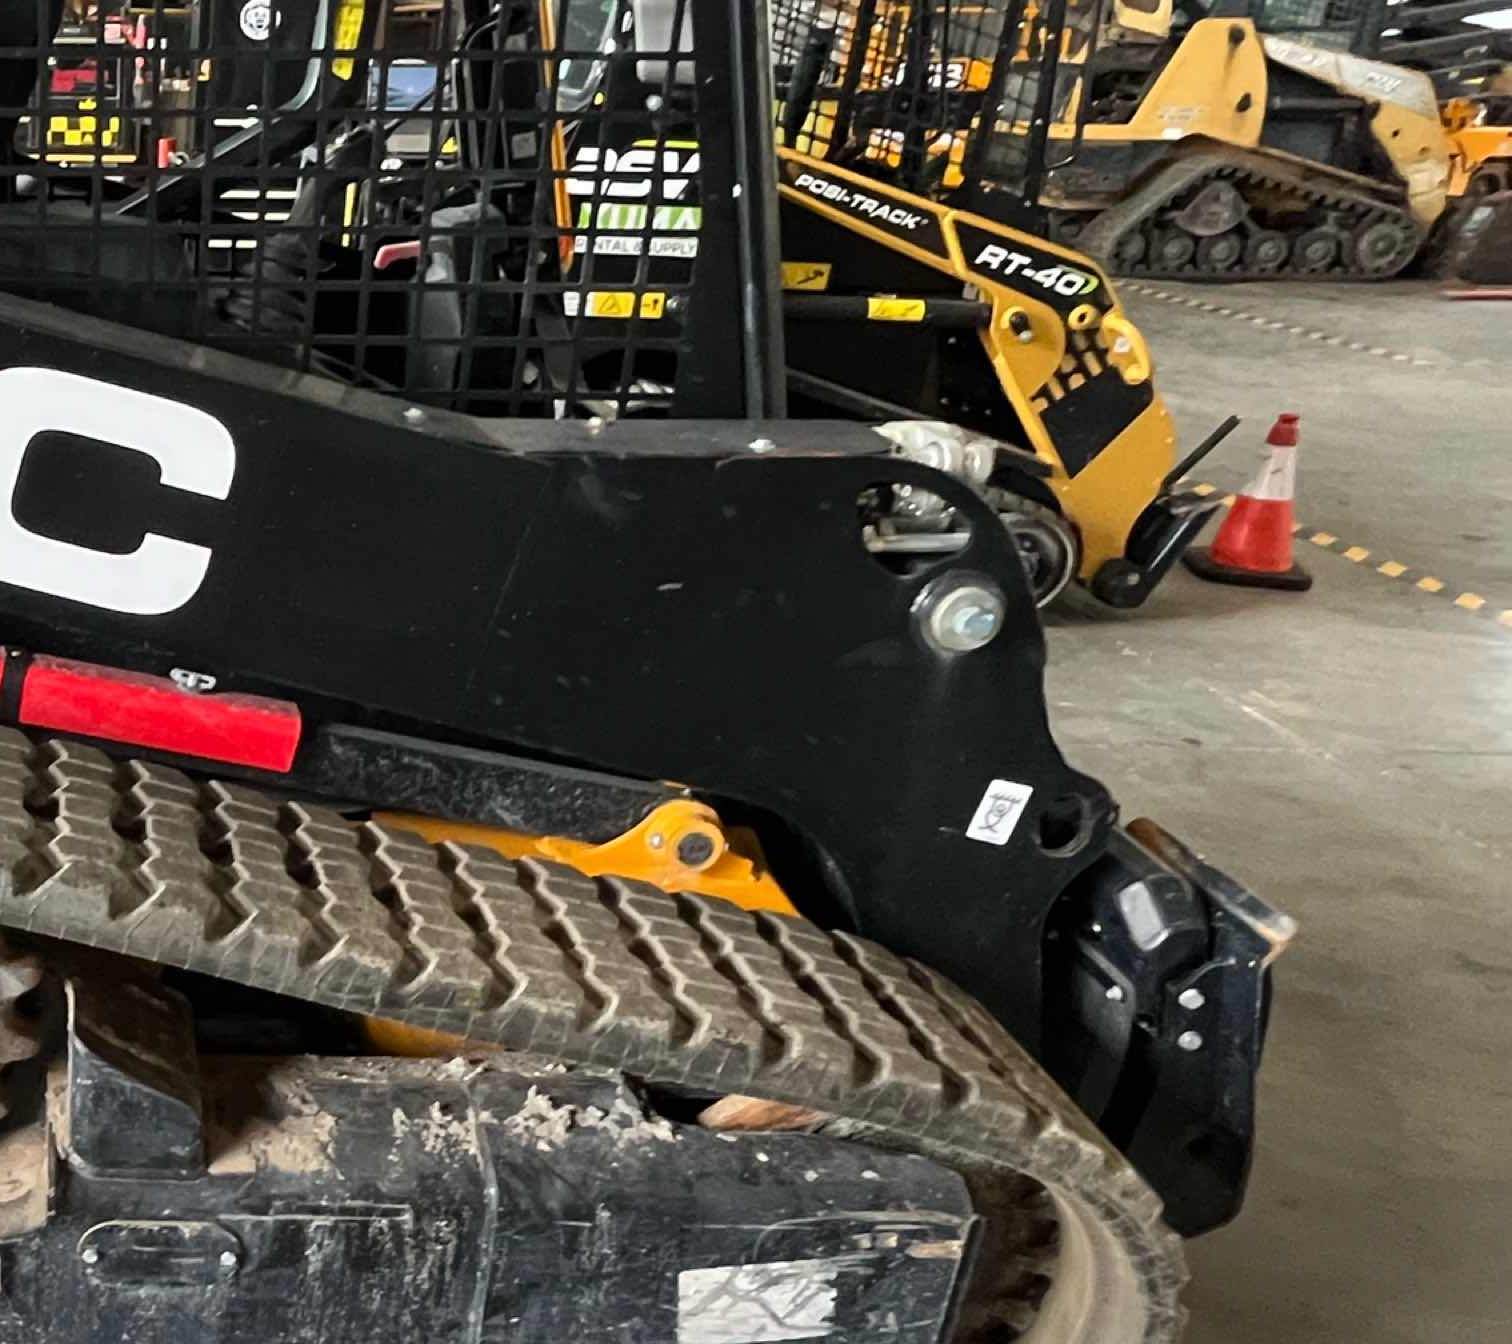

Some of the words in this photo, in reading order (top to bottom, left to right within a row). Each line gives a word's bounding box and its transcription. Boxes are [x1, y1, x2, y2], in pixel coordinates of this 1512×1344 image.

[794, 174, 923, 230] POSI-TRACK
[575, 238, 628, 253] RNTAL
[646, 240, 696, 256] UPPLY
[974, 244, 1087, 296] RT-40
